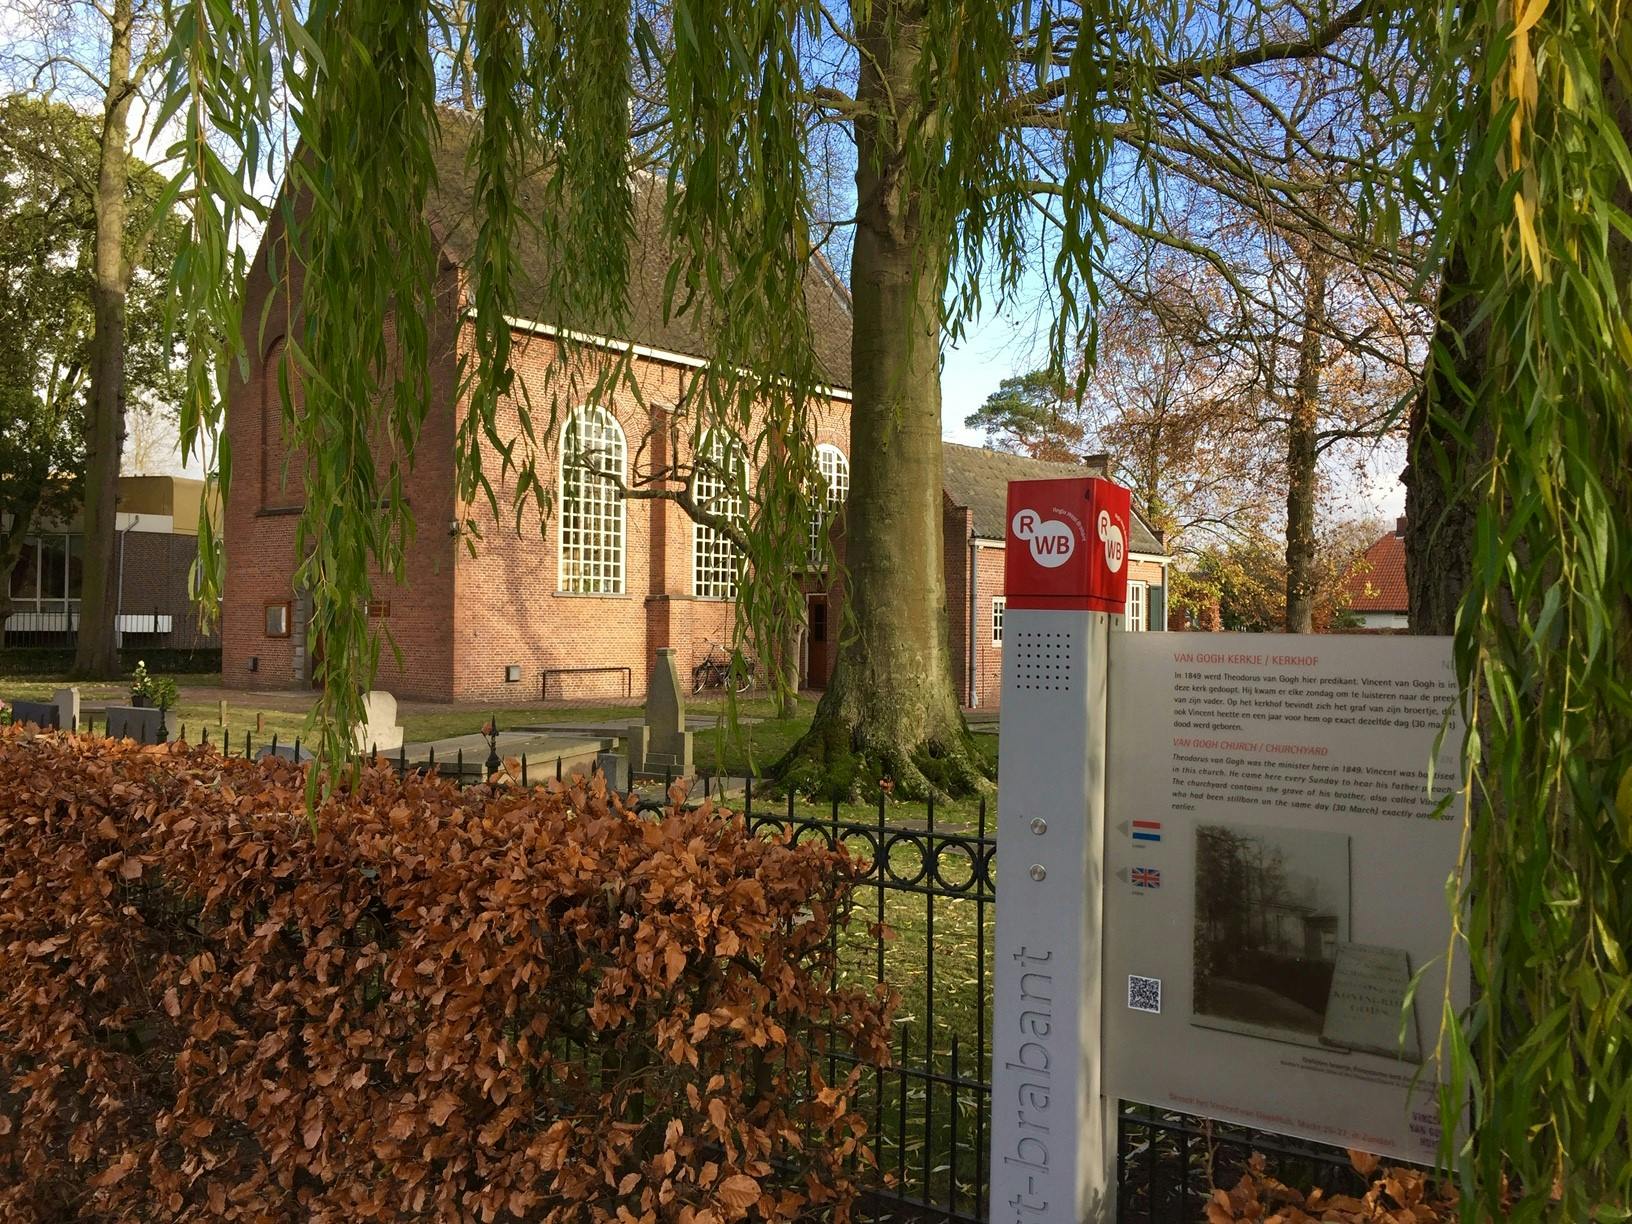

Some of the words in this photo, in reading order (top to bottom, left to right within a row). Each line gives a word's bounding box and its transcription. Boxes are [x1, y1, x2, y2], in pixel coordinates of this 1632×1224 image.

[1020, 516, 1034, 534] R
[1035, 536, 1070, 555] WB
[1101, 517, 1108, 536] R
[1107, 540, 1122, 560] WB
[1174, 654, 1193, 663] VAN
[1197, 654, 1225, 664] GOGH
[1228, 655, 1262, 665] KERKJE
[1272, 656, 1319, 666] KERKHOF
[1185, 672, 1202, 680] 1849
[1204, 673, 1221, 681] werd
[1224, 673, 1261, 682] Theodorus
[1279, 675, 1299, 685] Gogh
[1302, 675, 1317, 684] hier
[1361, 678, 1392, 687] Vincent
[1412, 680, 1435, 689] Gogh
[1448, 681, 1456, 689] in
[1192, 684, 1206, 692] kerk
[1242, 686, 1253, 695] Hij
[1255, 686, 1276, 695] kwam
[1288, 688, 1304, 696] elke
[1306, 688, 1333, 698] zondag
[1362, 691, 1396, 700] luisteren
[1420, 693, 1430, 701] de
[1188, 696, 1200, 705] zijn
[1204, 697, 1225, 705] vader.
[1227, 698, 1237, 707] Op
[1240, 698, 1251, 706] het
[1255, 700, 1282, 708] kerkhof
[1285, 701, 1313, 709] bevindt
[1316, 702, 1331, 710] zich
[1334, 703, 1347, 711] het
[1350, 704, 1366, 712] graf
[1386, 705, 1401, 714] zijn
[1188, 709, 1214, 717] Vincent
[1217, 710, 1239, 718] heette
[1268, 712, 1282, 721] jaar
[1322, 716, 1334, 724] op
[1335, 717, 1355, 725] exact
[1358, 717, 1392, 726] dezelfde
[1394, 719, 1409, 728] dag
[1412, 720, 1425, 728] (30
[1428, 721, 1455, 729] mat)
[1193, 721, 1210, 729] werd
[1173, 738, 1190, 747] VAN
[1193, 739, 1217, 749] GOGH
[1220, 740, 1258, 752] CHURCH
[1265, 743, 1328, 756] CHURCHYARD
[1173, 753, 1209, 763] Theodorus
[1225, 757, 1245, 767] Gogh
[1264, 760, 1276, 768] the
[1278, 761, 1310, 770] minister
[1311, 763, 1329, 771] here
[1331, 764, 1339, 772] in
[1365, 767, 1397, 776] Vincent
[1399, 770, 1415, 778] was
[1417, 770, 1455, 781] batised
[1182, 766, 1196, 774] this
[1264, 772, 1282, 781] here
[1284, 775, 1305, 784] every
[1308, 776, 1339, 786] Sunday
[1342, 778, 1351, 786] to
[1353, 779, 1373, 788] hear
[1375, 781, 1388, 789] his
[1391, 782, 1419, 791] father
[1187, 779, 1228, 789] churchyard
[1230, 783, 1262, 791] contains
[1266, 785, 1279, 793] the
[1281, 788, 1304, 796] grave
[1307, 788, 1316, 796] of
[1319, 790, 1331, 798] his
[1370, 793, 1387, 801] also
[1391, 796, 1417, 804] called
[1172, 790, 1188, 798] who
[1190, 791, 1203, 799] had
[1206, 793, 1224, 801] been
[1227, 795, 1259, 804] stillborn
[1275, 799, 1288, 807] the
[1314, 803, 1330, 812] day
[1333, 804, 1345, 812] (30
[1349, 805, 1379, 815] March)
[1382, 808, 1414, 818] exactly
[1004, 946, 1052, 1224] t-brabant
